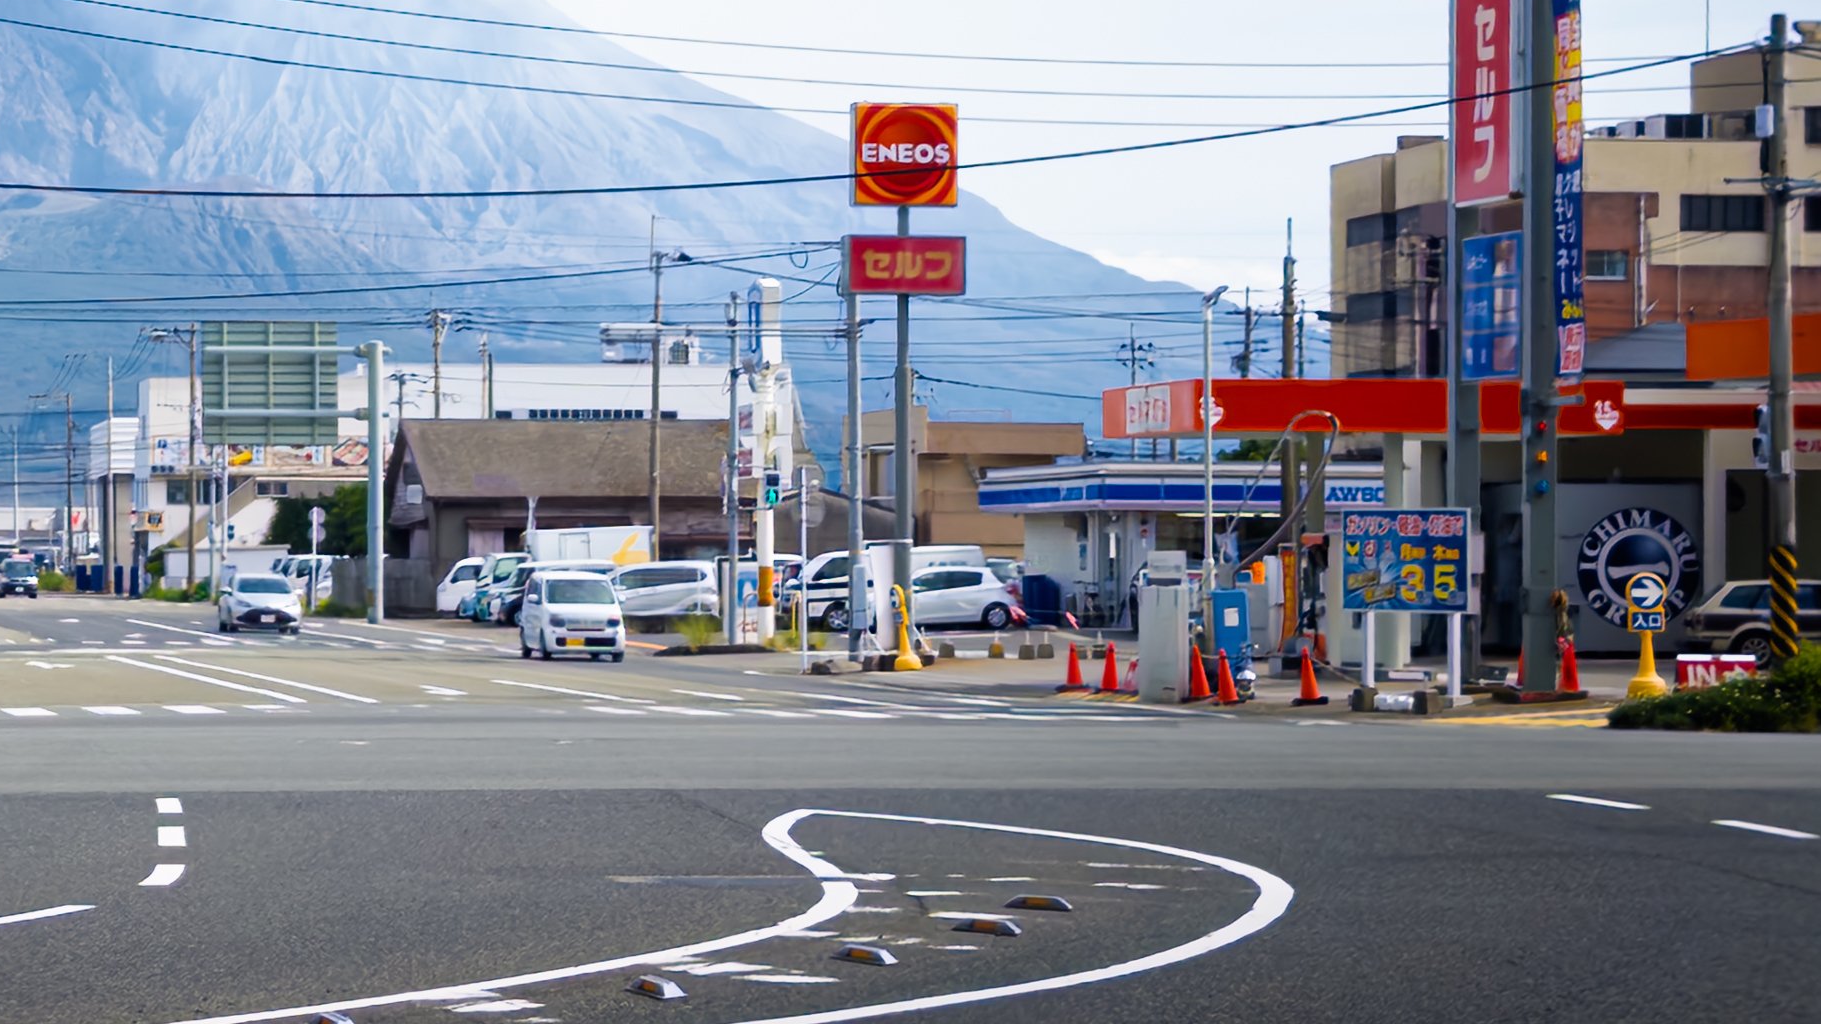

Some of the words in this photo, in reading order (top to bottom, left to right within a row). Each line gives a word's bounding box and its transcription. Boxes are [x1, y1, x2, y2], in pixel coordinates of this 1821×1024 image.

[1473, 3, 1496, 182] セルフ
[862, 143, 950, 164] ENEOS
[862, 248, 952, 280] セルフ
[1580, 508, 1698, 573] ICHIMARU
[1400, 564, 1425, 602] 3
[1433, 564, 1458, 601] 5
[1633, 614, 1662, 629] 入口
[1686, 663, 1718, 688] IN
